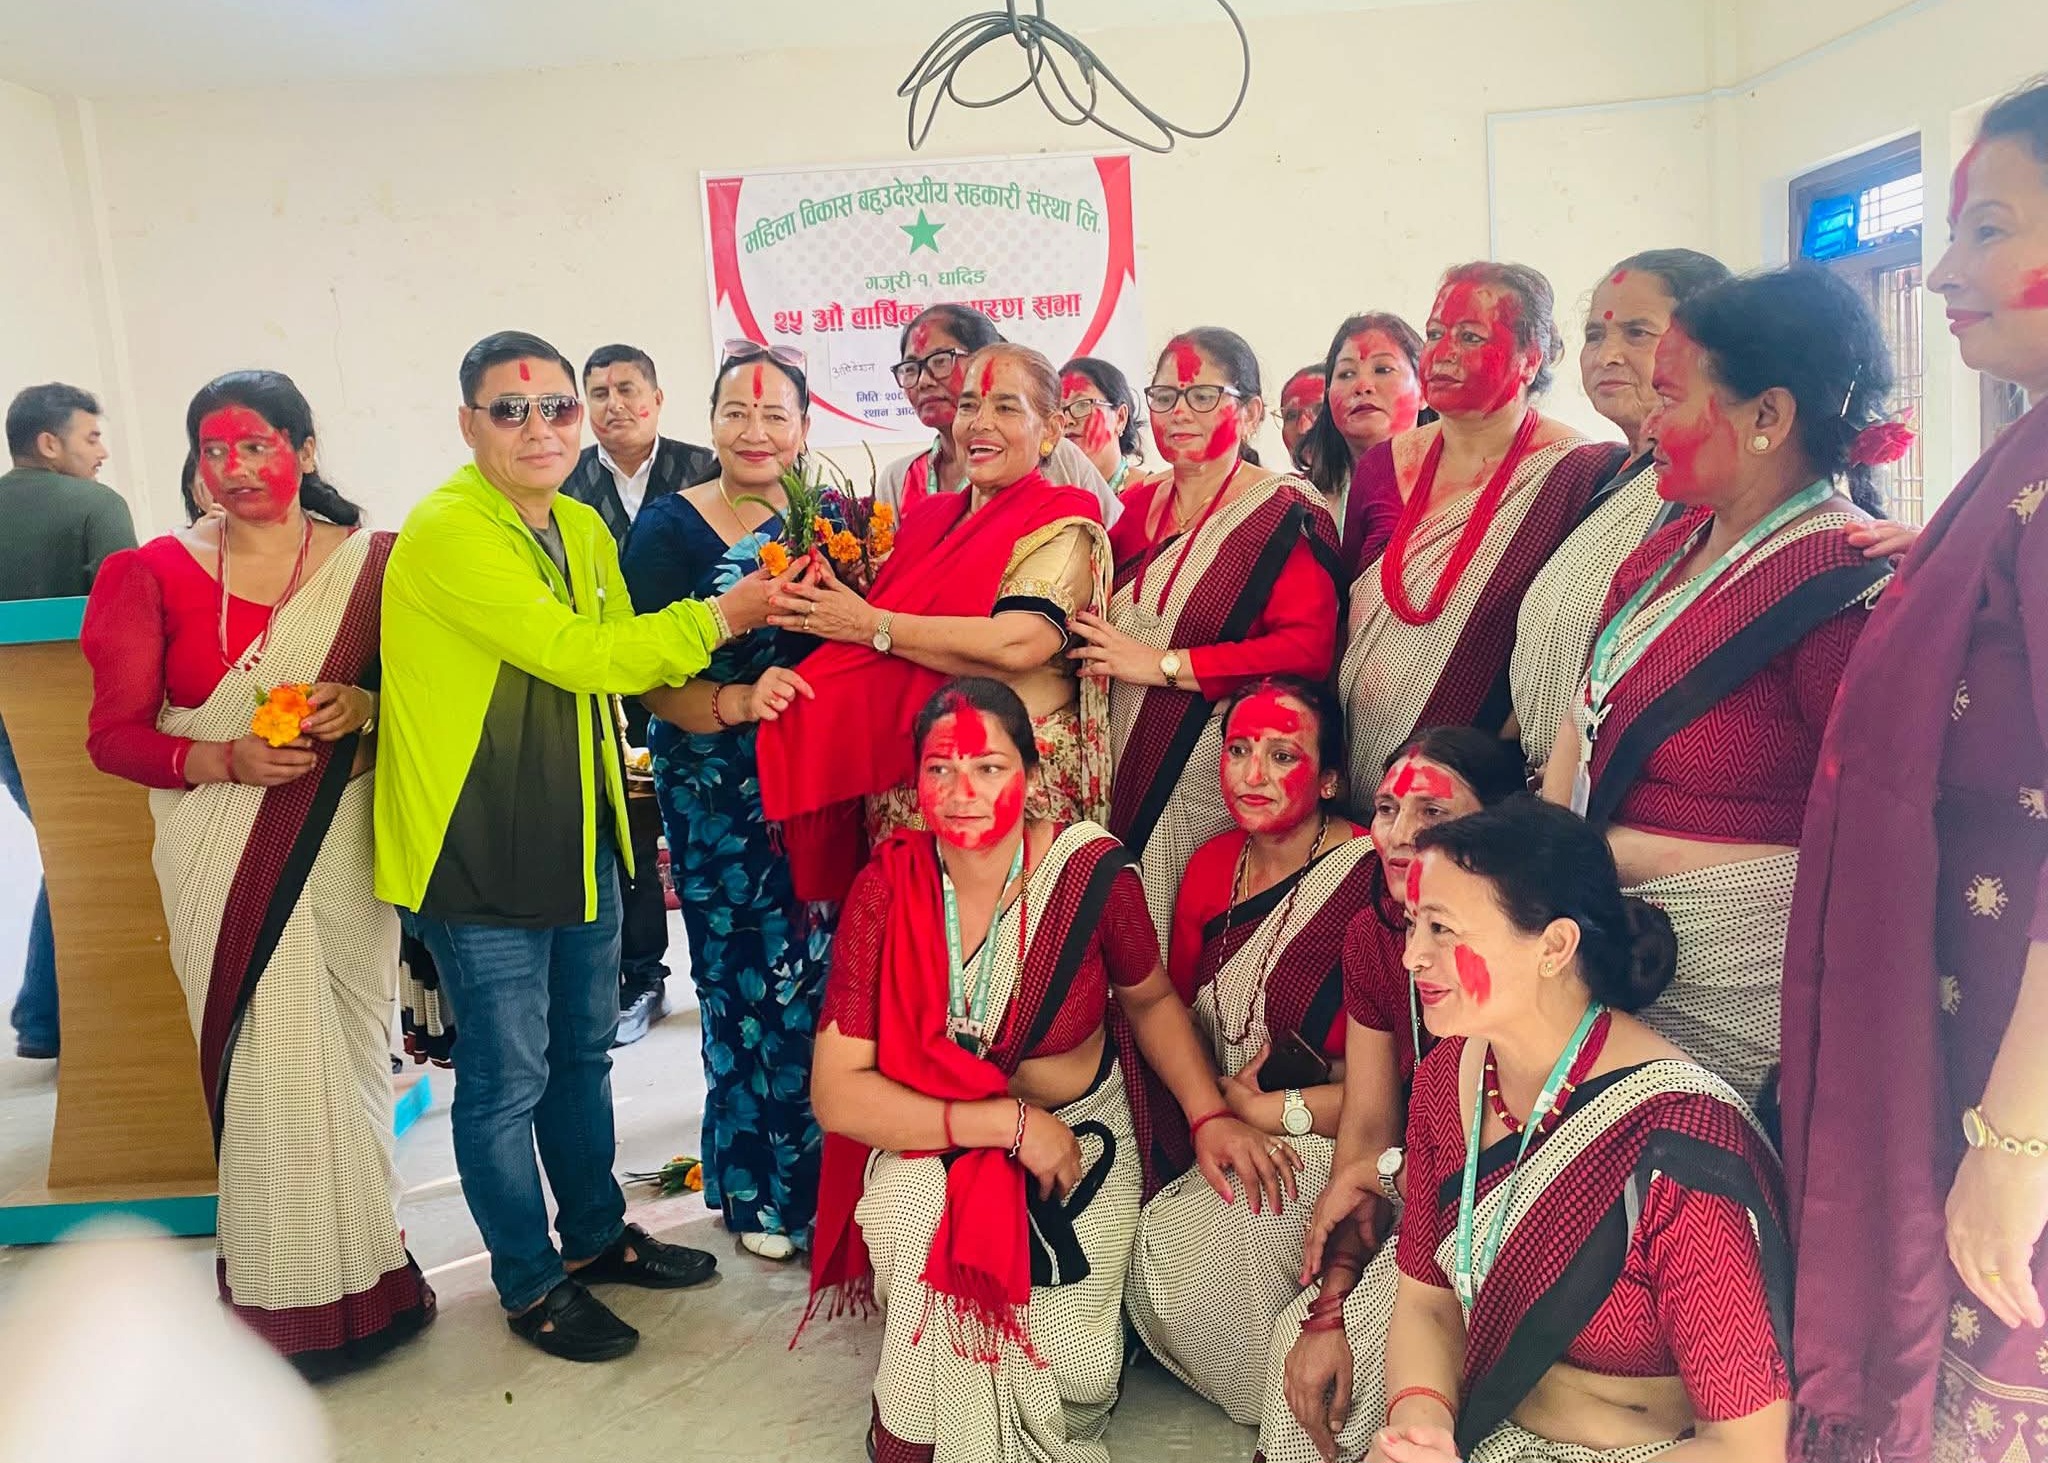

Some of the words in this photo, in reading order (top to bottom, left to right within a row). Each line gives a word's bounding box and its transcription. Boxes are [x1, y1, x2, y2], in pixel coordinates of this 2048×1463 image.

[742, 217, 797, 254] महिला
[799, 199, 854, 229] विकास
[954, 182, 1021, 209] सहकारी
[1027, 189, 1072, 223] संस्था
[774, 309, 803, 335] २५
[1032, 292, 1082, 320] सभा
